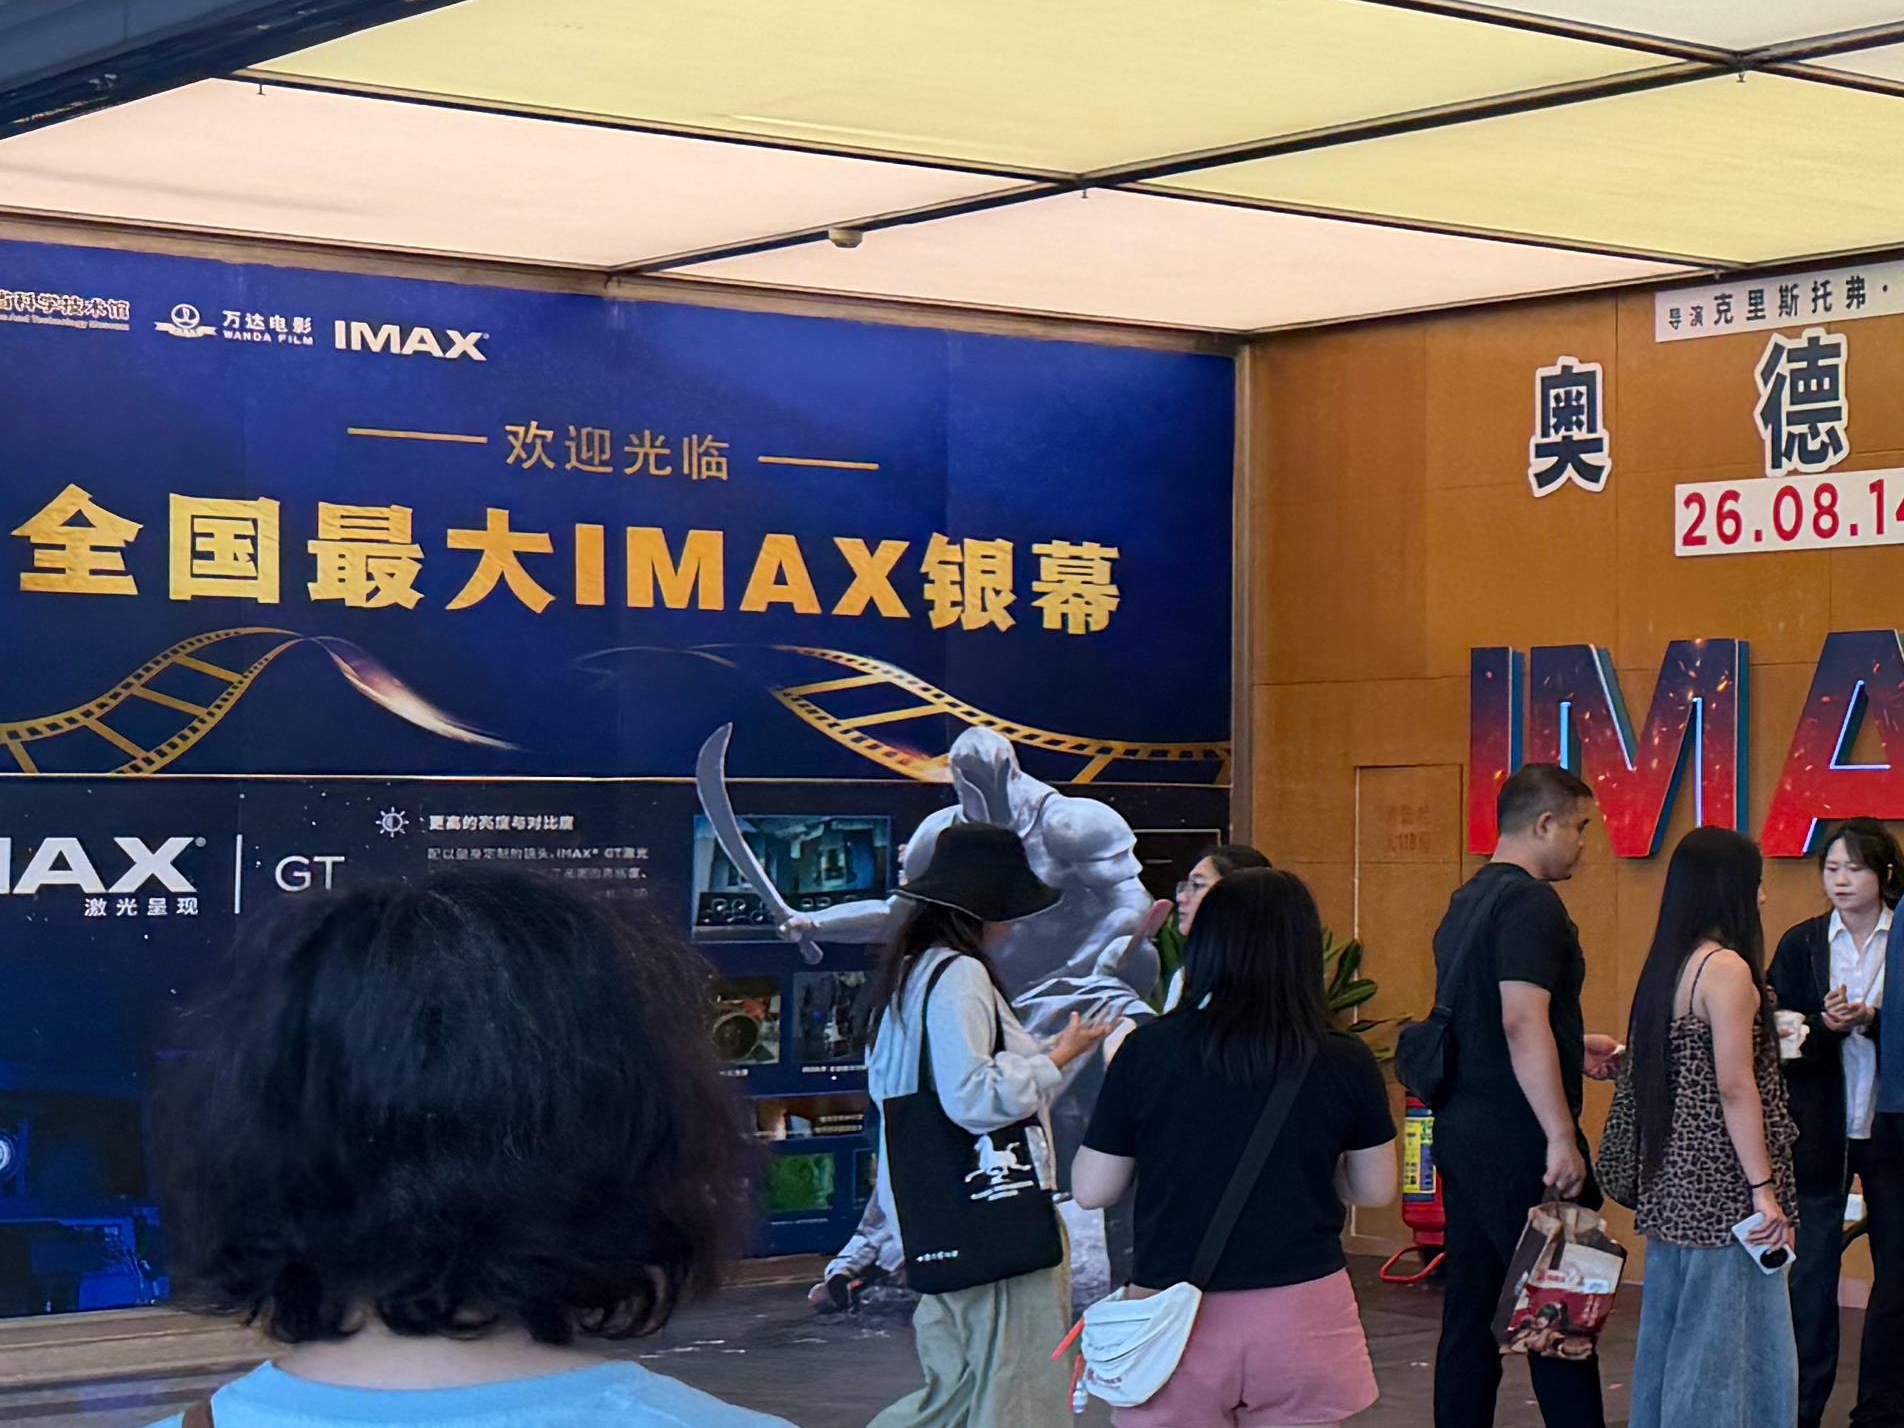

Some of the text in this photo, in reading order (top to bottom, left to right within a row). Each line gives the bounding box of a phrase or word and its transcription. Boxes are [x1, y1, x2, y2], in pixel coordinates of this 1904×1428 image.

[222, 309, 313, 335] 万达电影
[223, 329, 314, 346] WANDA FILM
[504, 420, 731, 481] 欢迎光临
[0, 836, 198, 894] AX
[275, 855, 346, 892] GT
[84, 896, 199, 917] 激光呈现
